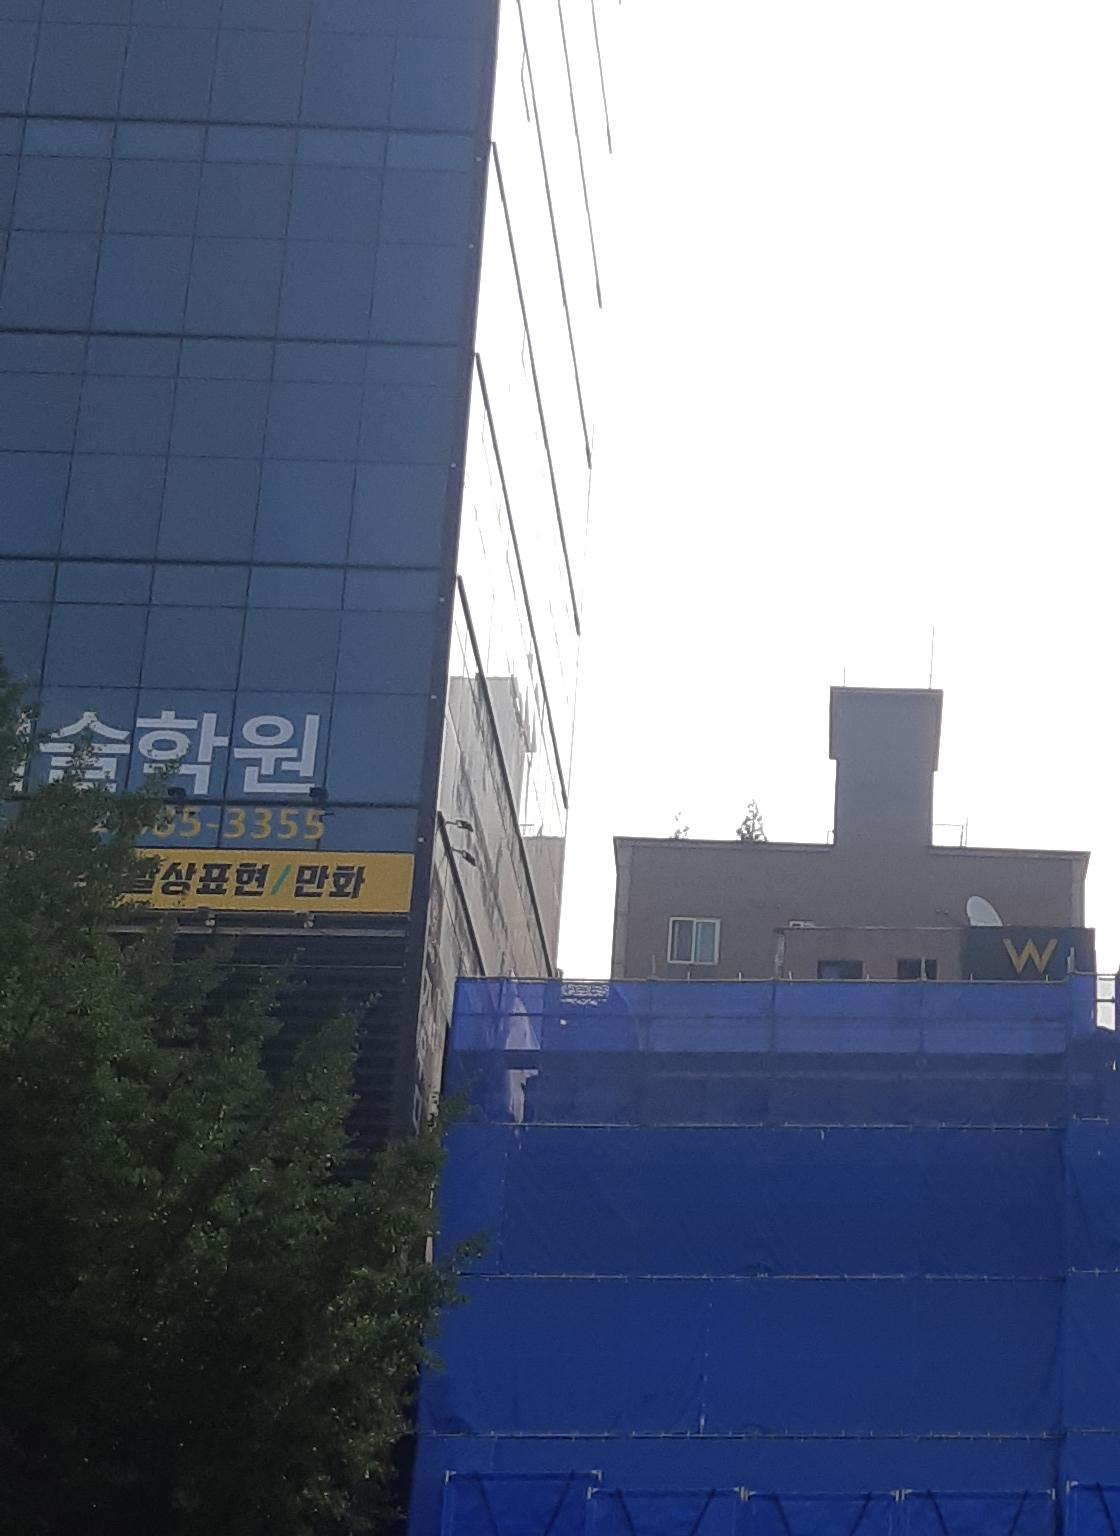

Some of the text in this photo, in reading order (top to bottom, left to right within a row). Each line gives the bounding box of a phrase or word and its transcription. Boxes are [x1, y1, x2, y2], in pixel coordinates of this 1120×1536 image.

[10, 710, 321, 796] 술학원
[140, 806, 325, 841] 85-3355
[1002, 937, 1059, 975] W
